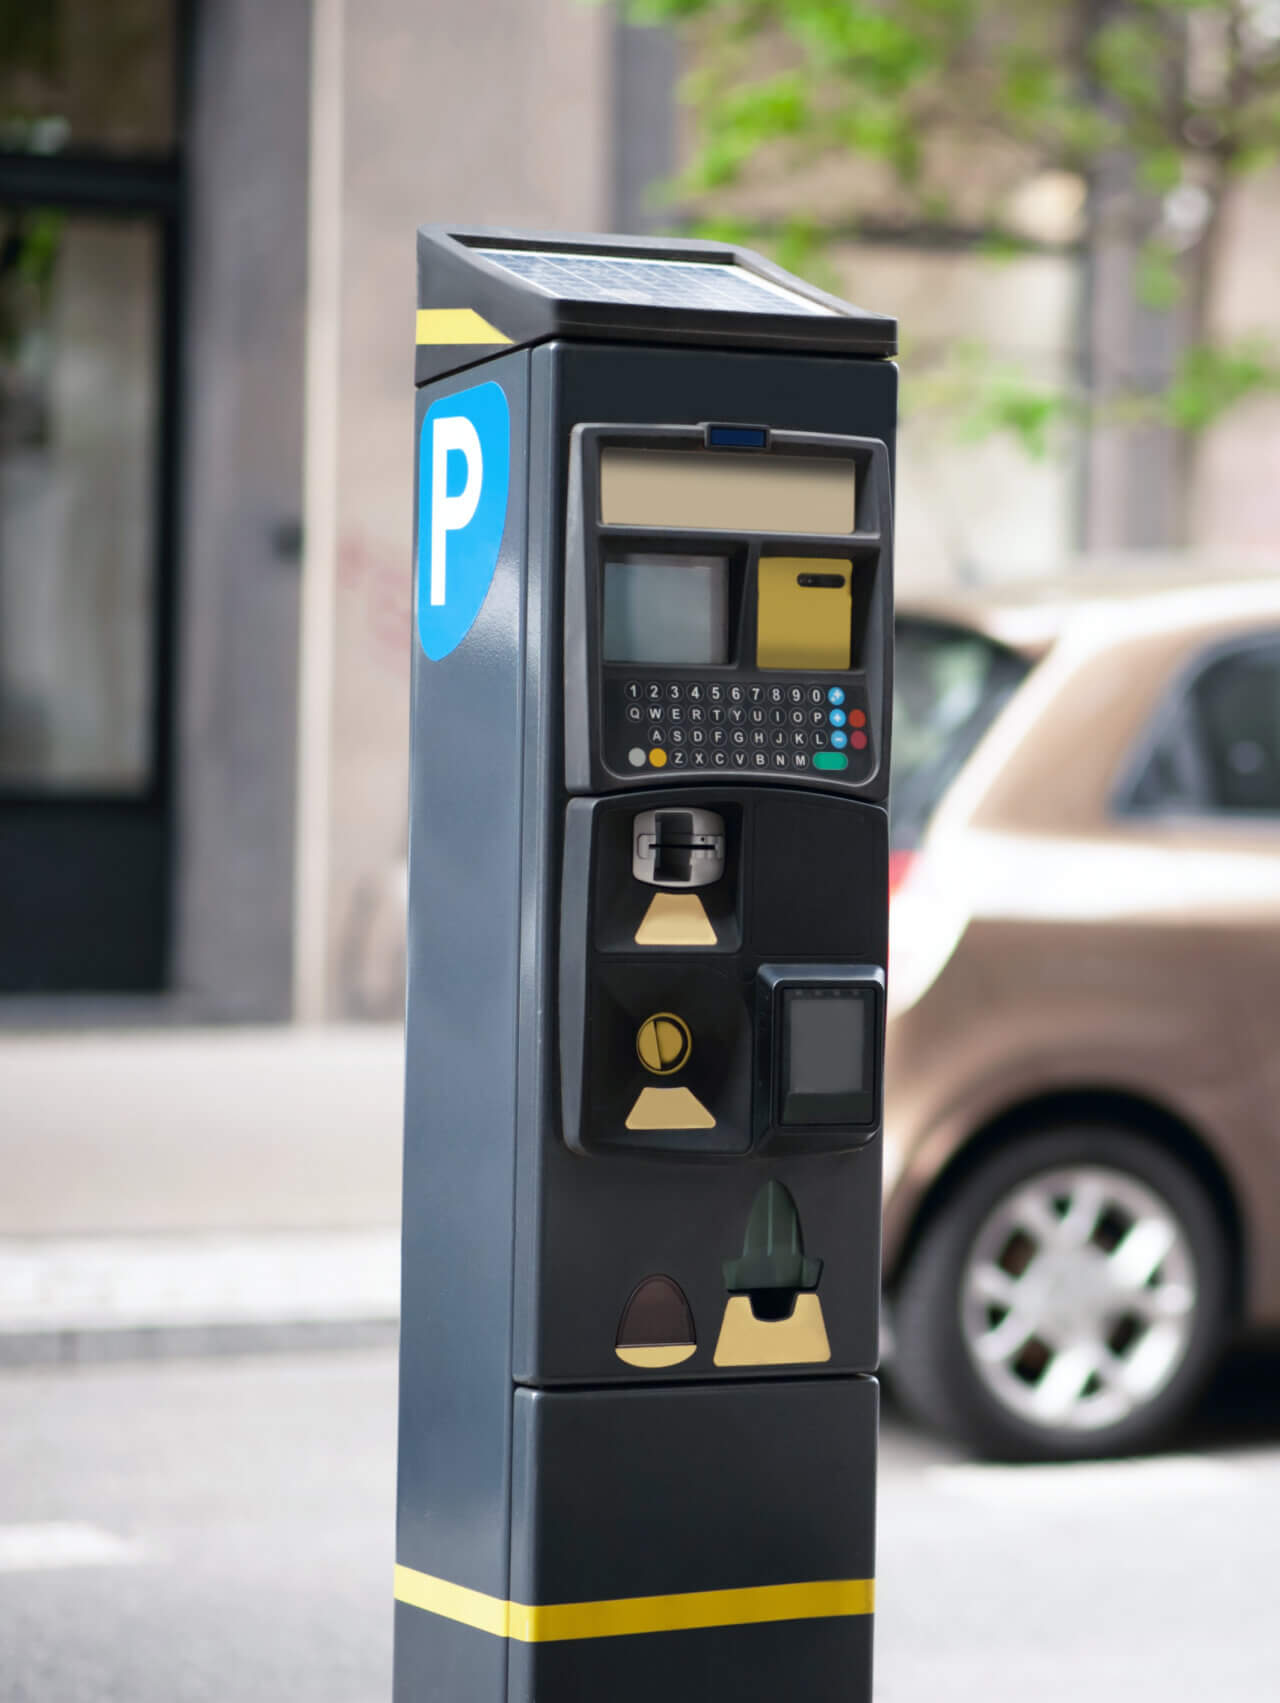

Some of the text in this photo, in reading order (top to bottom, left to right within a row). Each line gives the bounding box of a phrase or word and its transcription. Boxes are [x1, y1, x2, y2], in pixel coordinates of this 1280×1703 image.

[431, 416, 483, 605] P
[650, 685, 658, 698] 2
[671, 686, 679, 698] 3
[691, 686, 699, 699] 4
[712, 687, 720, 699] 5
[732, 687, 740, 700] 6
[752, 688, 760, 700] 7
[773, 689, 780, 701] 8
[792, 689, 800, 701] 9
[813, 690, 820, 702] 0
[630, 708, 640, 719] Q
[649, 708, 661, 719] W
[672, 709, 680, 719] E
[692, 709, 701, 720] R
[712, 710, 720, 720] T
[733, 710, 741, 720] Y
[753, 711, 762, 722] U
[793, 712, 802, 722] O
[814, 712, 822, 722] P
[652, 730, 823, 744] A S D F G H J K L
[675, 753, 806, 766] Z X C V B N M
